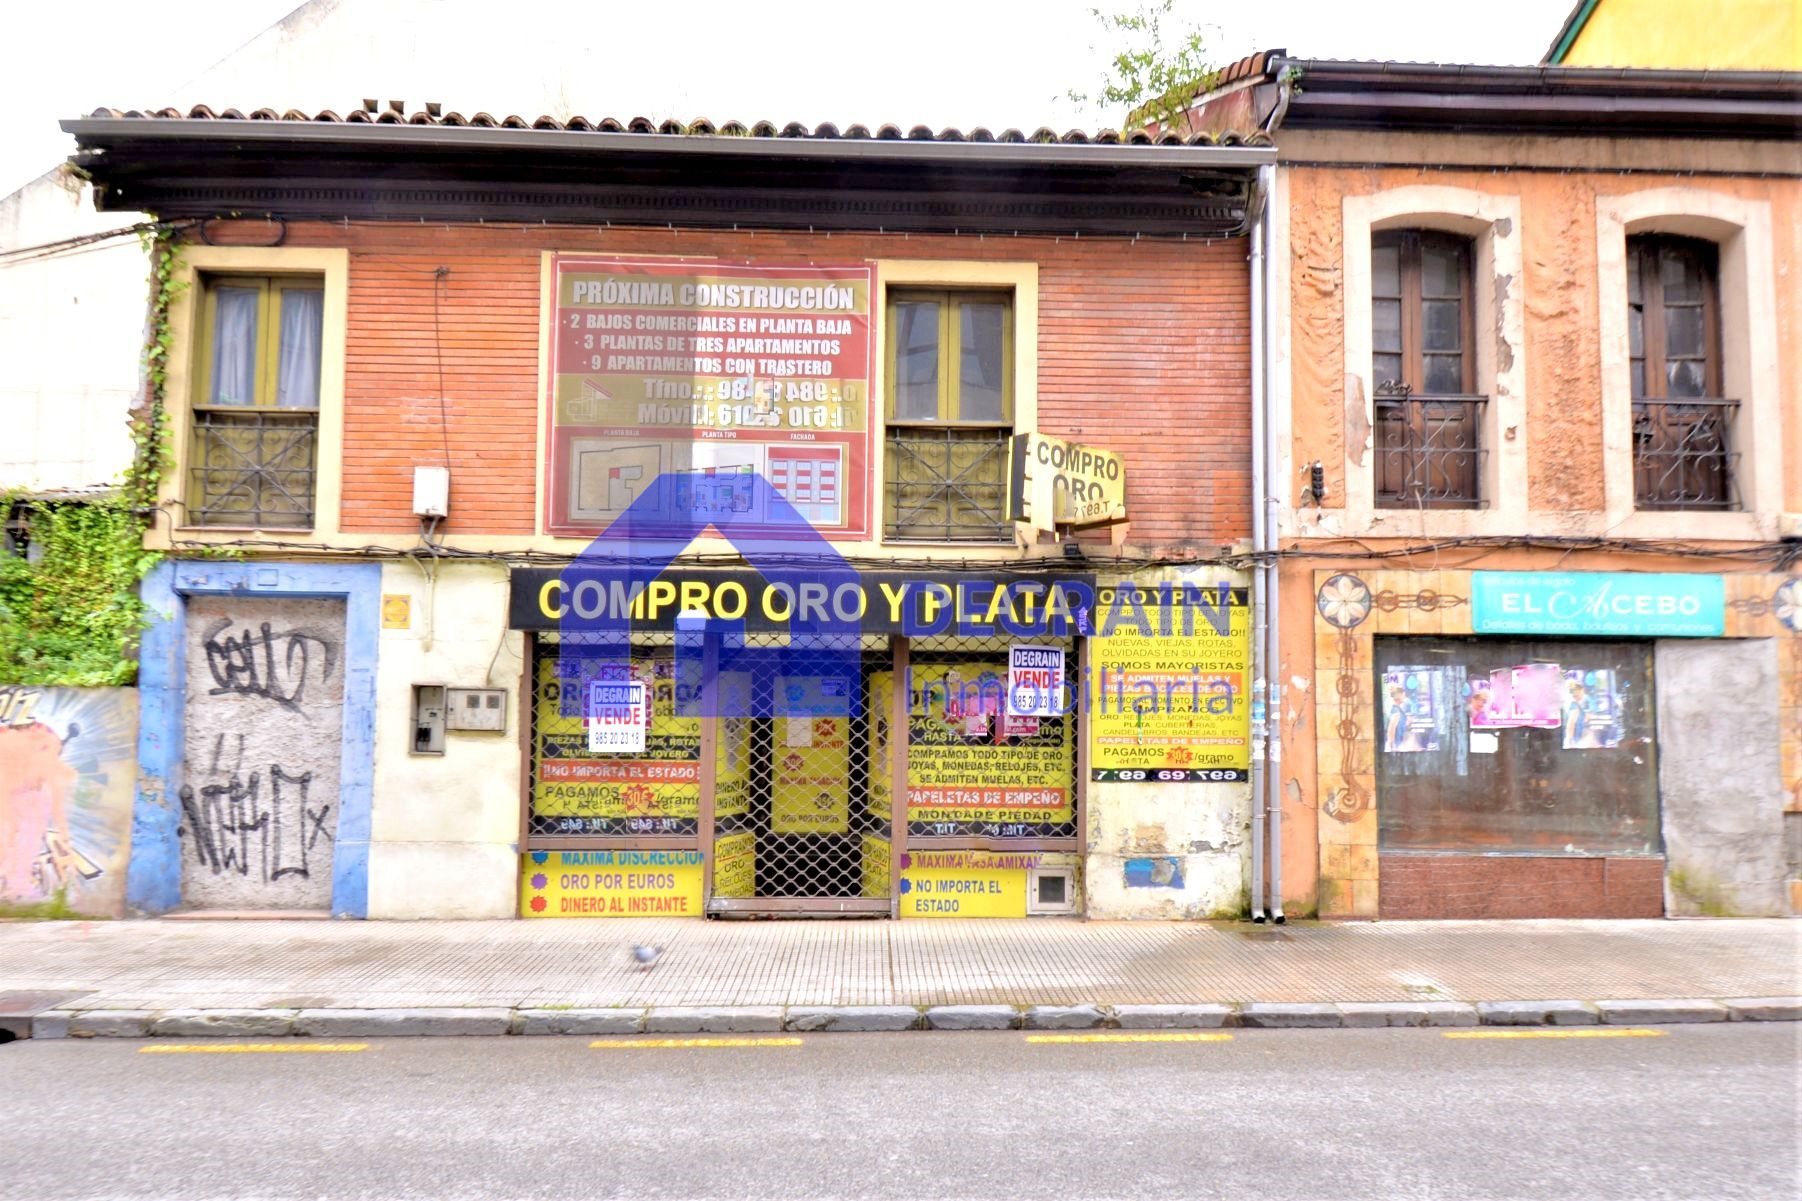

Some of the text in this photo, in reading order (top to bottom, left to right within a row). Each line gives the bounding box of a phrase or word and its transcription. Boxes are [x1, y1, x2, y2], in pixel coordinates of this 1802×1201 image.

[572, 277, 856, 310] PRÓXIMA CONSTRUCCIÓN
[570, 313, 852, 335] 2 BAJOS COMERCIALES EN PLANTA BAJA
[584, 334, 841, 355] 3 PLANTAS DE TRES APARTAMENTOS
[591, 355, 832, 376] 9 APARTAMENTOS CON TRASTERO
[702, 431, 737, 439] PLANTA TIPO
[1037, 441, 1119, 481] COMPRO
[1053, 474, 1104, 503] ORO
[538, 579, 749, 621] COMPRO
[762, 581, 867, 623] ORO
[879, 583, 911, 623] Y
[924, 583, 1075, 624] PLATA
[1099, 589, 1240, 606] ORO Y PLATA
[1502, 580, 1701, 619] EL ACEBO
[1097, 608, 1141, 617] COMPRO
[1126, 628, 1174, 637] IMPORTA
[1177, 628, 1192, 637] EL
[1014, 650, 1060, 667] DEGRAIN
[1102, 649, 1242, 659] OLVIDADAS EN SU JOYERO
[1101, 661, 1244, 670] SOMOS MAYORISTAS
[1013, 670, 1060, 689] VENDE
[1127, 674, 1174, 683] ADMITEN
[1177, 674, 1222, 683] MUELAS
[595, 687, 641, 703] DEGRAIN
[1013, 695, 1058, 708] 985 20 23 18
[595, 707, 641, 725] VENDE
[1122, 705, 1219, 713] COMPRAMOS
[595, 731, 607, 745] 985
[610, 731, 618, 745] 20
[621, 731, 629, 745] 23
[908, 750, 1063, 760] COMPRAMOS TODO TIPO DE ORO
[1103, 747, 1165, 757] PAGAMOS
[1194, 752, 1234, 763] /gramo
[571, 766, 643, 777] IMPORTA EL
[920, 774, 931, 784] SE
[934, 774, 978, 784] ADMITEN
[545, 786, 620, 799] PAGAMOS
[908, 790, 1060, 805] PAPELETAS DE EMPEÑO
[560, 873, 675, 889] ORO POR EUROS
[916, 879, 1002, 894] NO IMPORTA EL
[561, 896, 687, 912] DINERO AL INSTANTE
[915, 898, 960, 912] ESTADO
